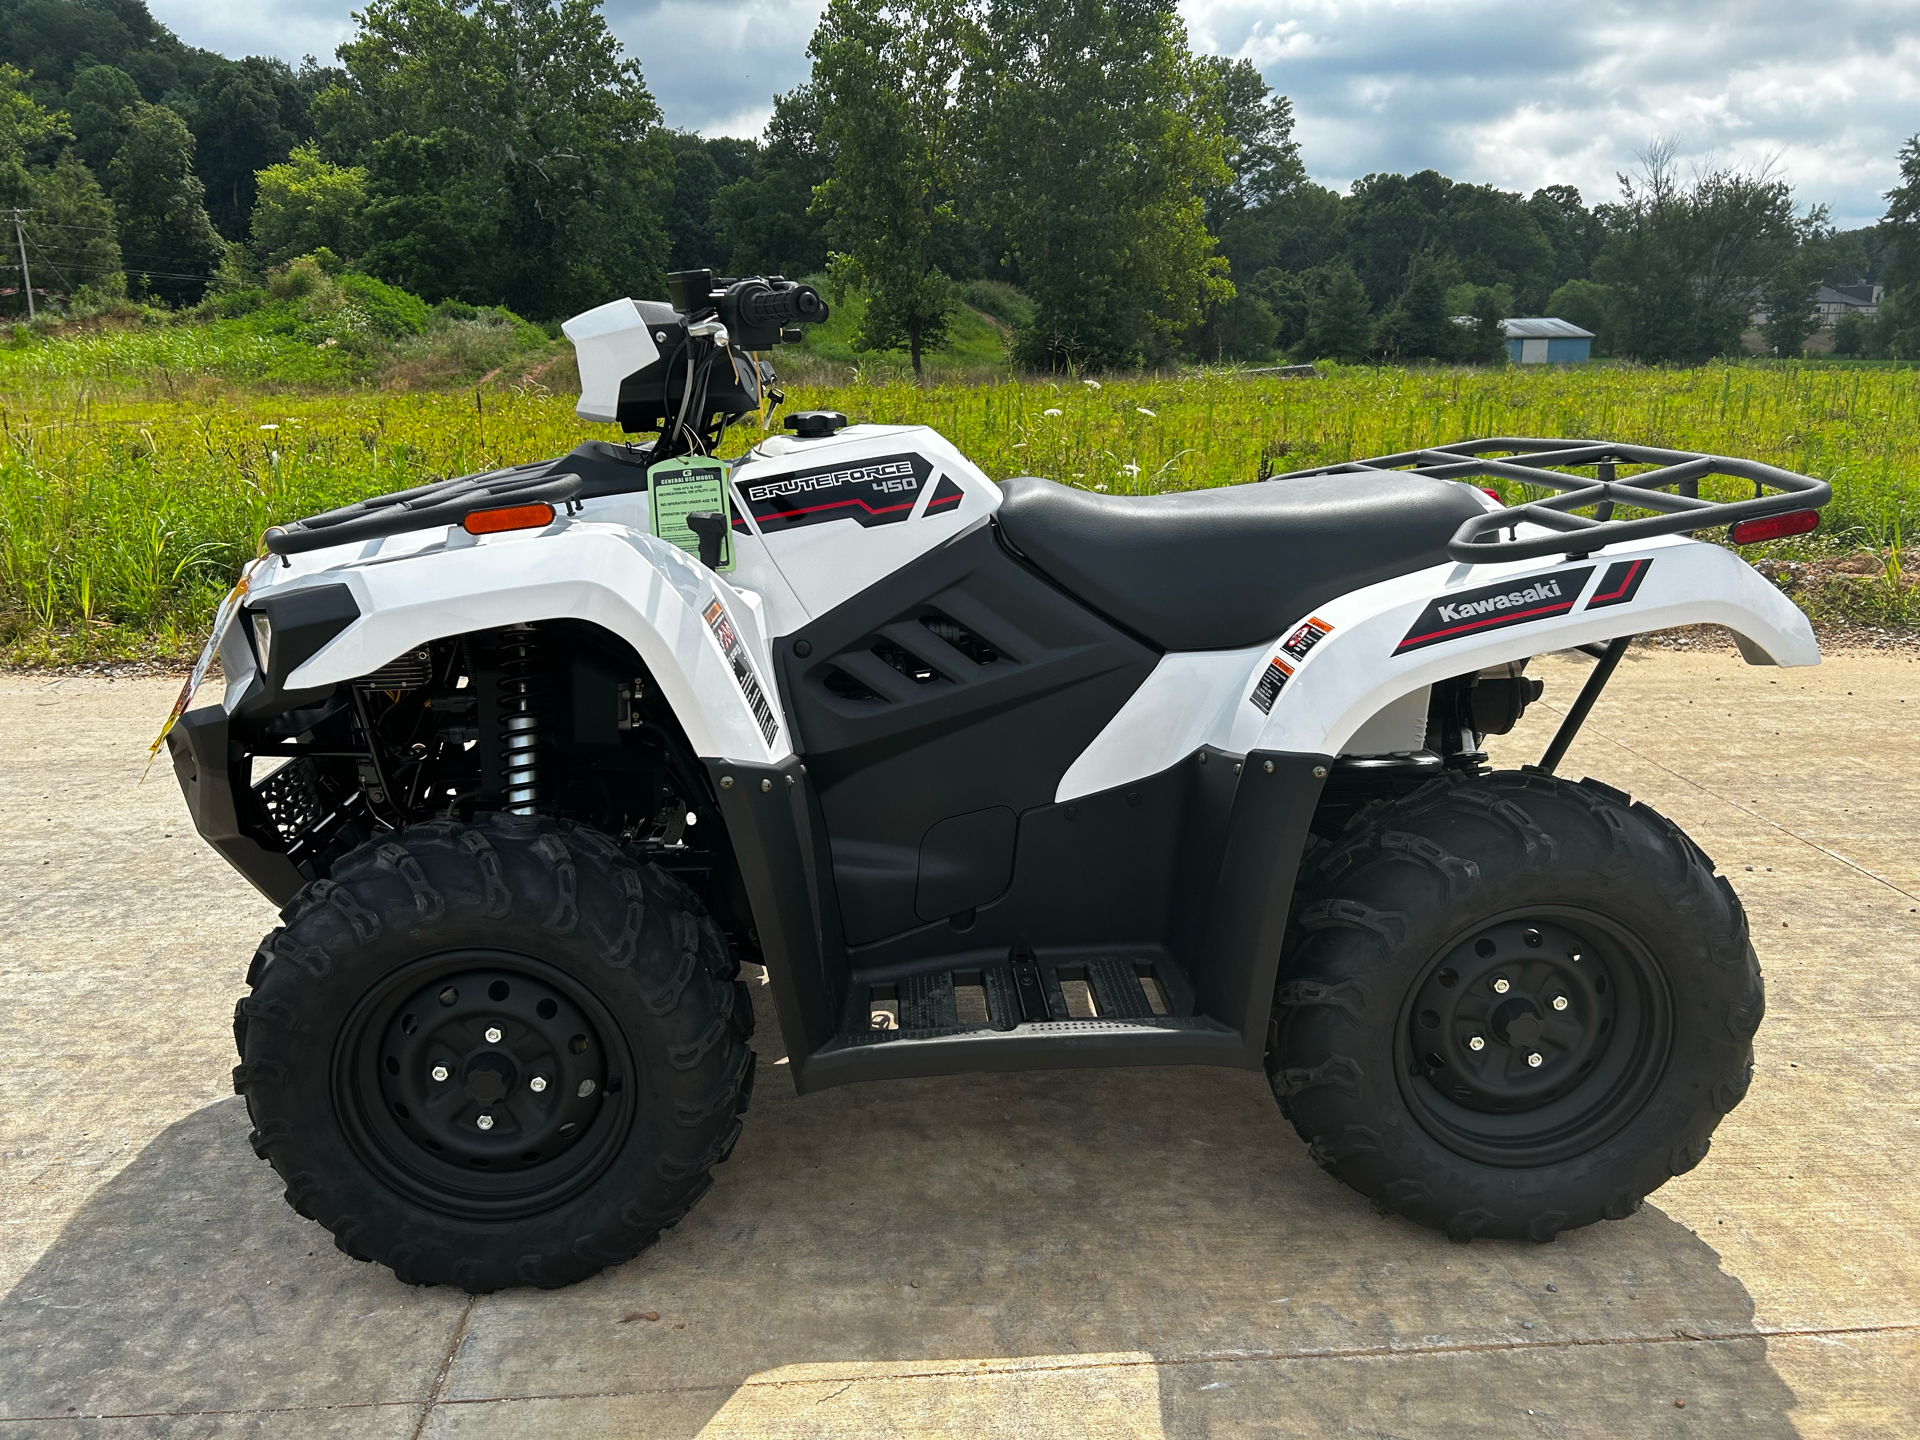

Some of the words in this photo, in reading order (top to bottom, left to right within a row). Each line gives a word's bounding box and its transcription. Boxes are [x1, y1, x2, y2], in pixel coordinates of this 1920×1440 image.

[749, 476, 833, 501] BRUTE
[832, 461, 914, 484] FORCE
[872, 477, 918, 494] 450
[1437, 579, 1563, 623] Kawasaki
